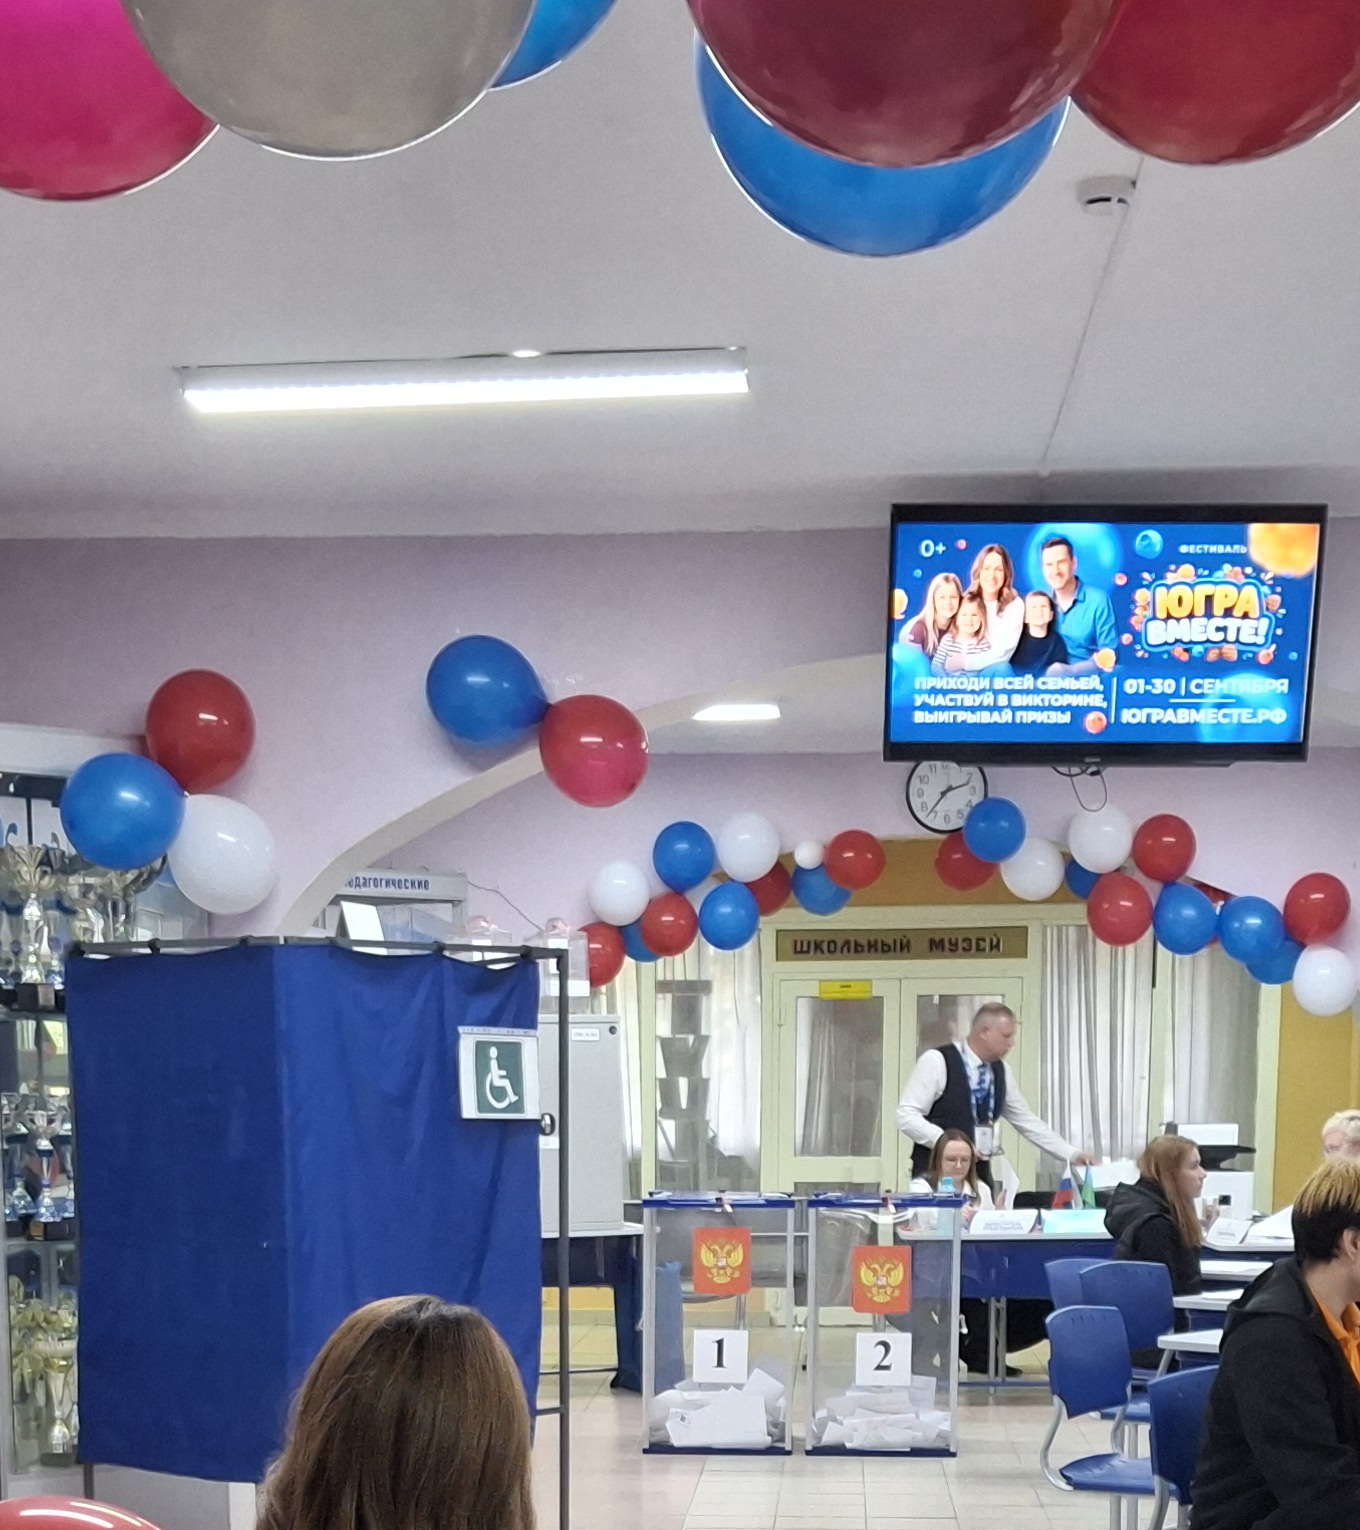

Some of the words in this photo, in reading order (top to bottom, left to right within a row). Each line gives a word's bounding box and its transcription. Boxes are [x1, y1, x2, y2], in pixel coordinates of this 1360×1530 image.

[920, 539, 947, 558] 0+
[1179, 544, 1248, 554] ФЕСТИВАЛЬ
[1155, 584, 1260, 619] ЮГРА
[1146, 617, 1270, 645] ВМЕСТЕ!
[915, 676, 990, 691] ПРИХОДИ
[993, 674, 1035, 690] ВСЕЙ
[1037, 674, 1104, 691] СЕМЬЕЙ,
[1124, 678, 1176, 694] 01-30
[1190, 678, 1289, 694] СЕНТЯБРЯ
[914, 691, 995, 707] УЧАСТВУЙ
[997, 694, 1009, 706] В
[1011, 694, 1107, 708] ВИКТОРИНЕ,
[914, 709, 1013, 724] ВЫИГРЫВАЙ
[1016, 711, 1071, 724] ПРИЗЫ
[1121, 708, 1287, 724] ЮГРАВМЕСТЕ.РФ
[345, 876, 430, 890] едагогические
[793, 935, 912, 955] ШКОЛЬНЫЙ
[929, 933, 1003, 953] МУЗЕЙ
[712, 1338, 728, 1369] 1
[872, 1340, 893, 1371] 2
